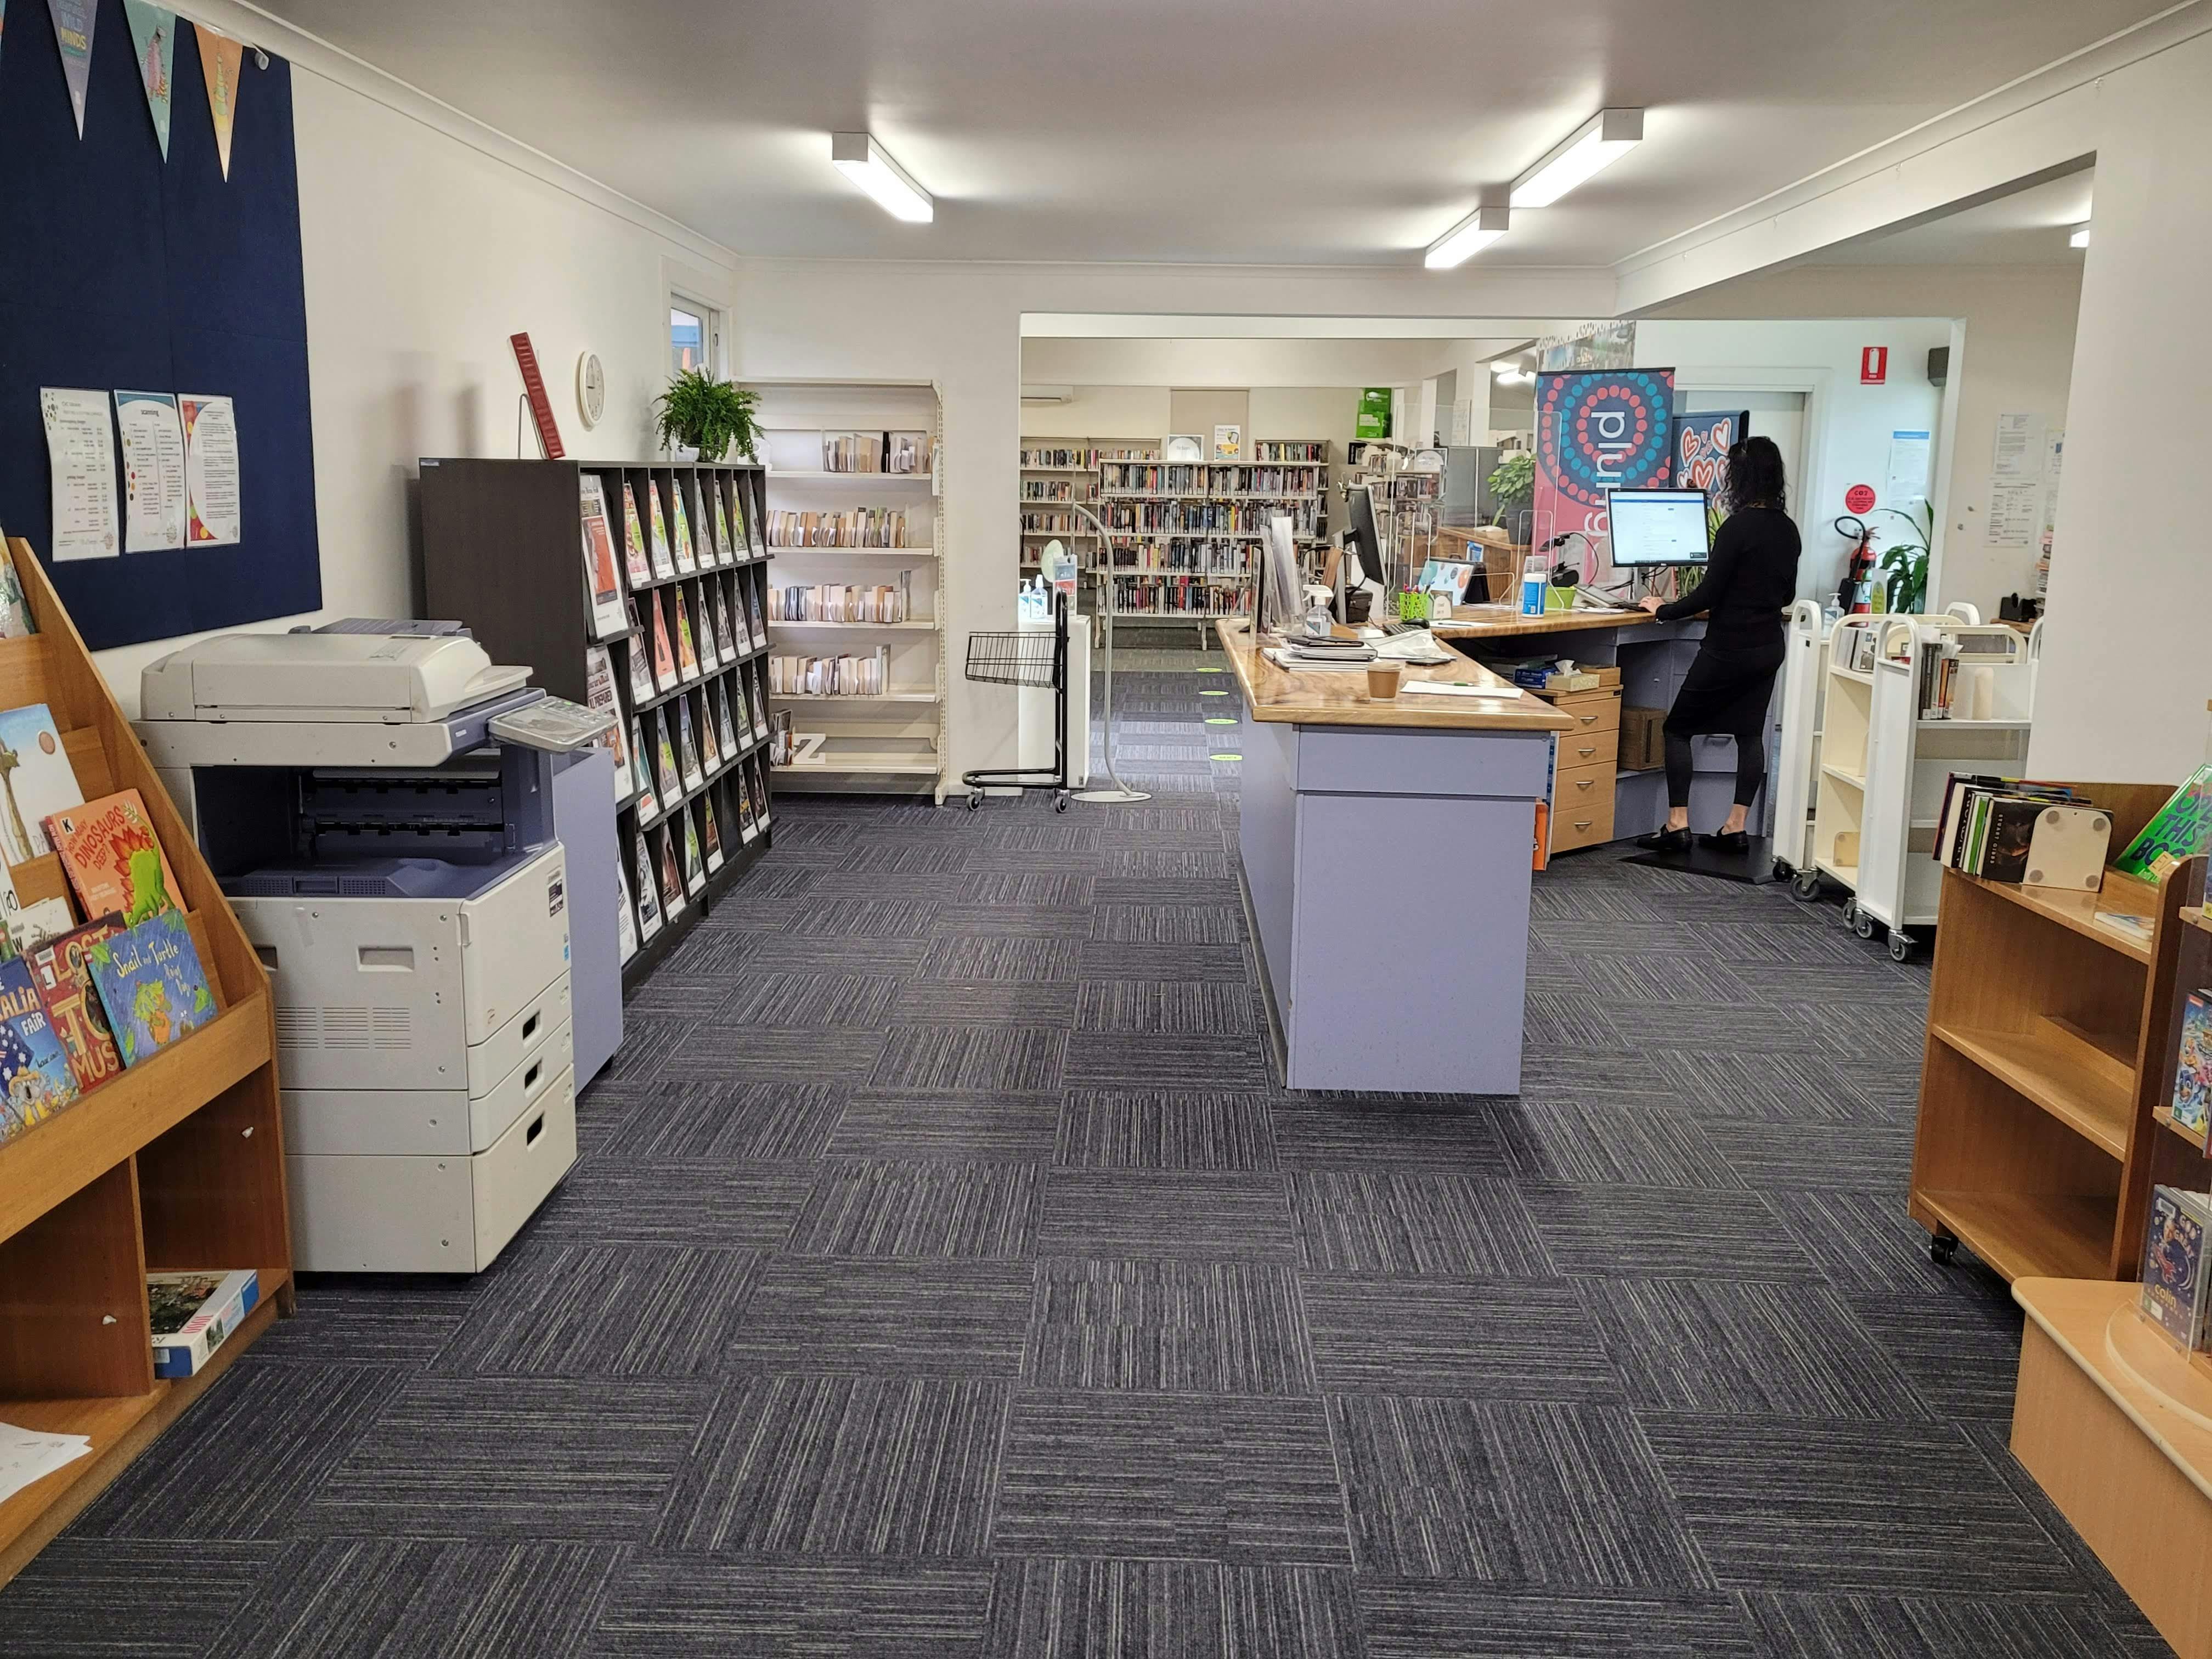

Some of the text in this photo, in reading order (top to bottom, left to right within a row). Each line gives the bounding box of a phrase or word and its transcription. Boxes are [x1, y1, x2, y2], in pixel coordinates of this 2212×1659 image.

[60, 26, 86, 50] MINDS
[1584, 411, 1632, 557] plung
[62, 819, 73, 833] K
[75, 805, 125, 869] DINOSAURS
[2155, 814, 2207, 847] THIS
[93, 843, 110, 871] DEEP?
[12, 936, 23, 953] W
[52, 924, 109, 983] LOST
[113, 944, 143, 978] Snail
[148, 939, 179, 966] Turtle
[43, 973, 52, 986] L
[70, 1041, 120, 1093] MUS
[2155, 1283, 2177, 1309] colin
